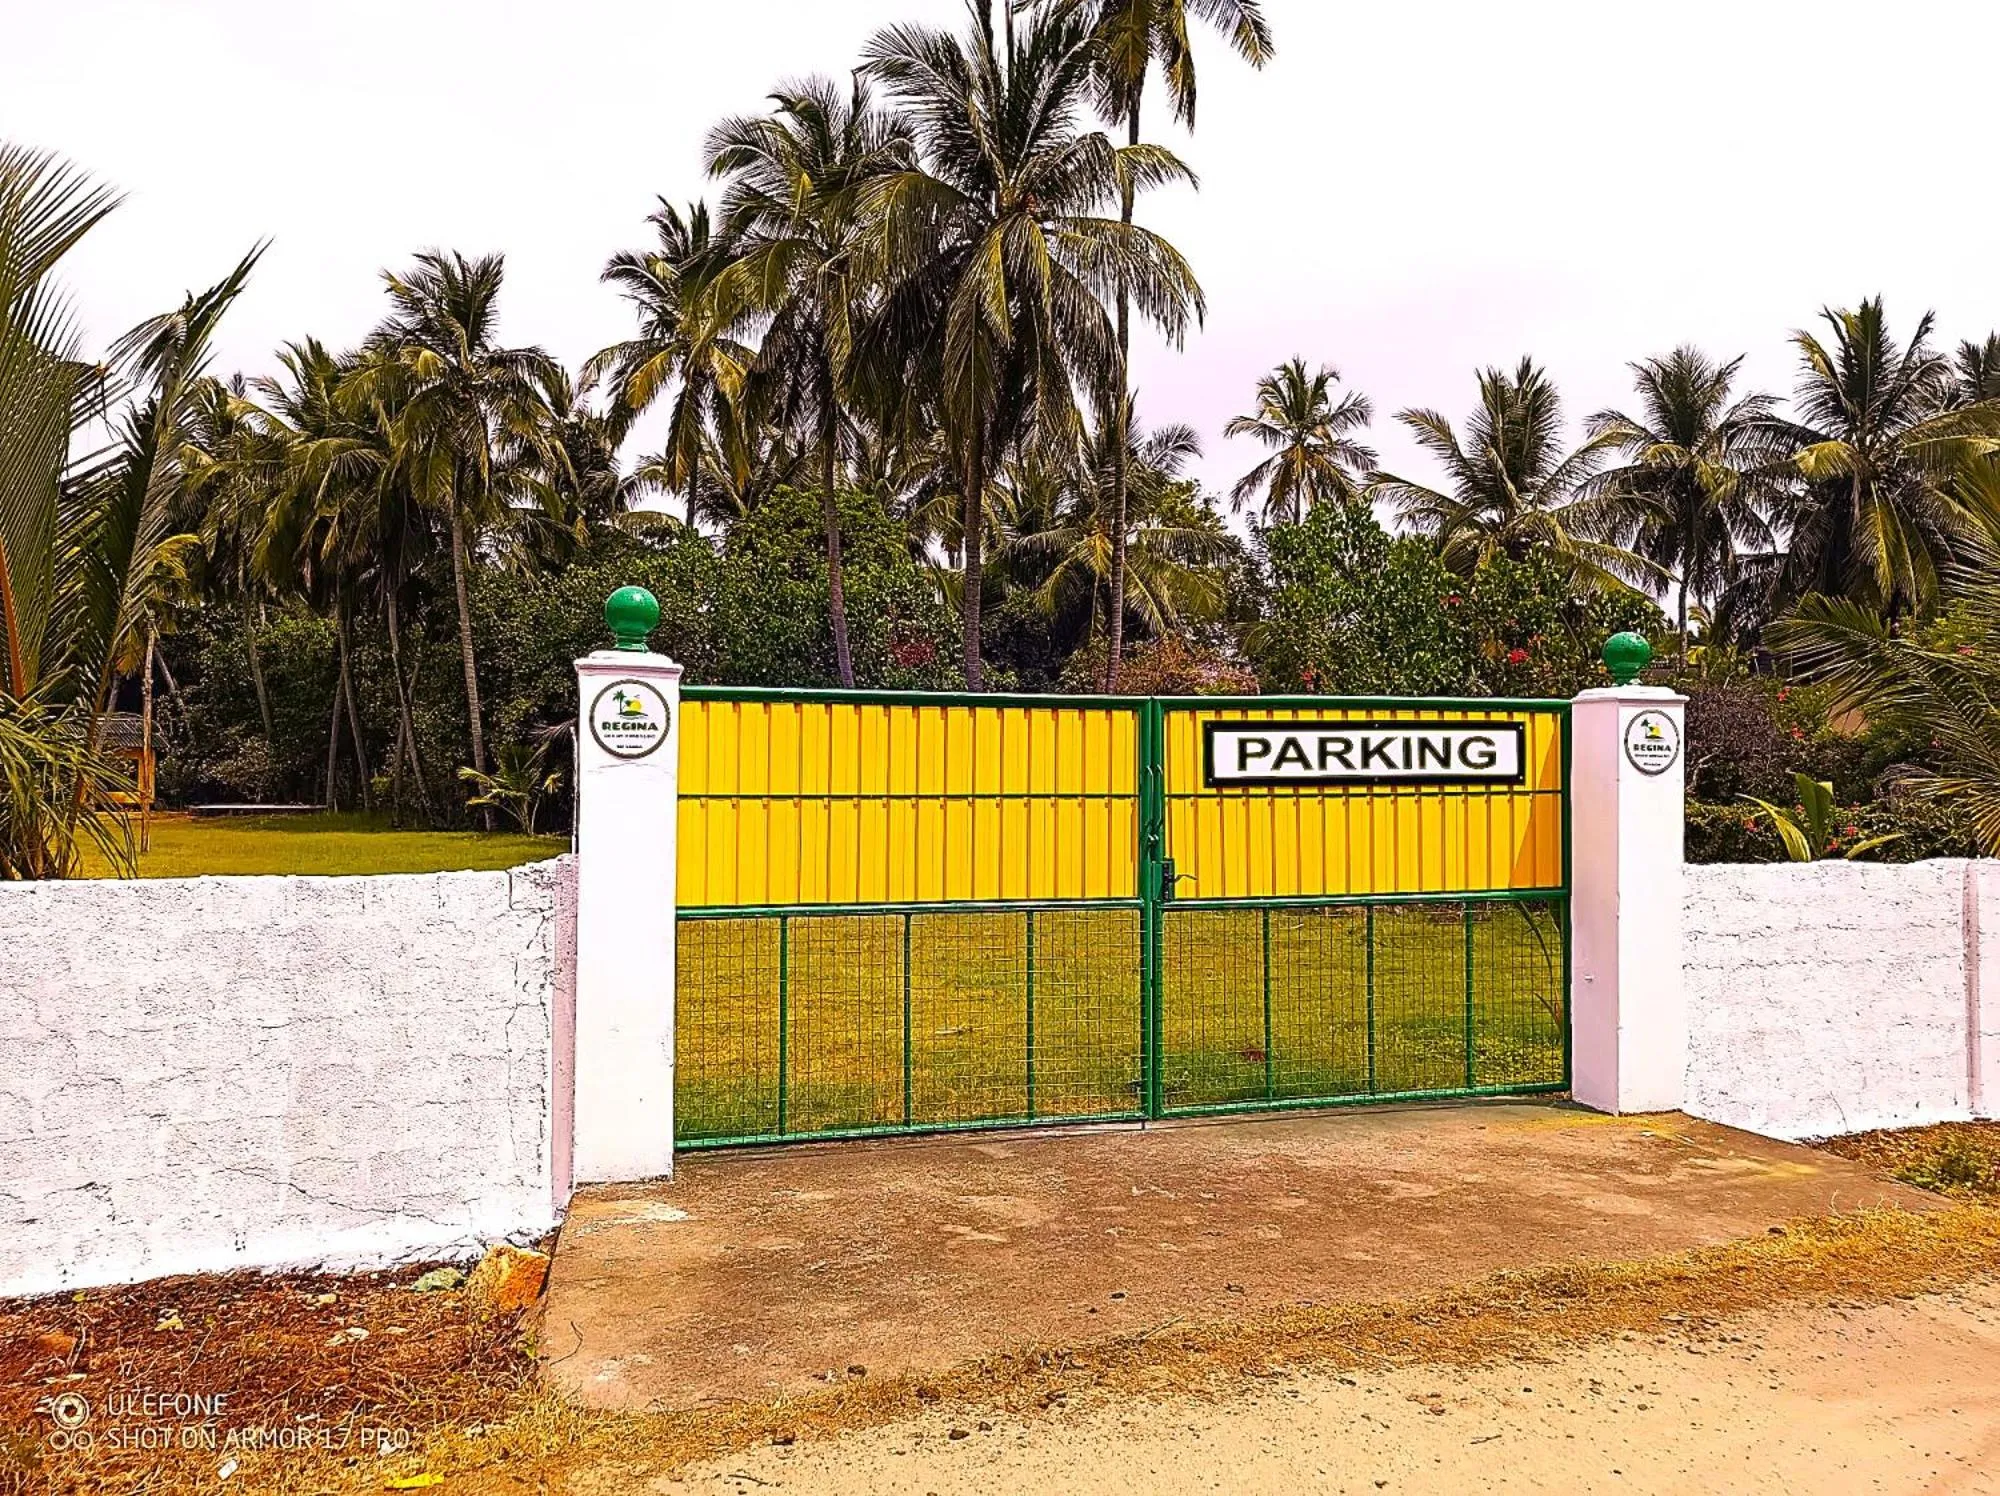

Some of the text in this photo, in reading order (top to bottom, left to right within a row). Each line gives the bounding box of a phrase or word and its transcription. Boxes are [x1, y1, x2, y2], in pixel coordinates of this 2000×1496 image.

[602, 721, 659, 731] REGINA
[1237, 735, 1497, 771] PARKING
[1634, 744, 1671, 752] REGINA
